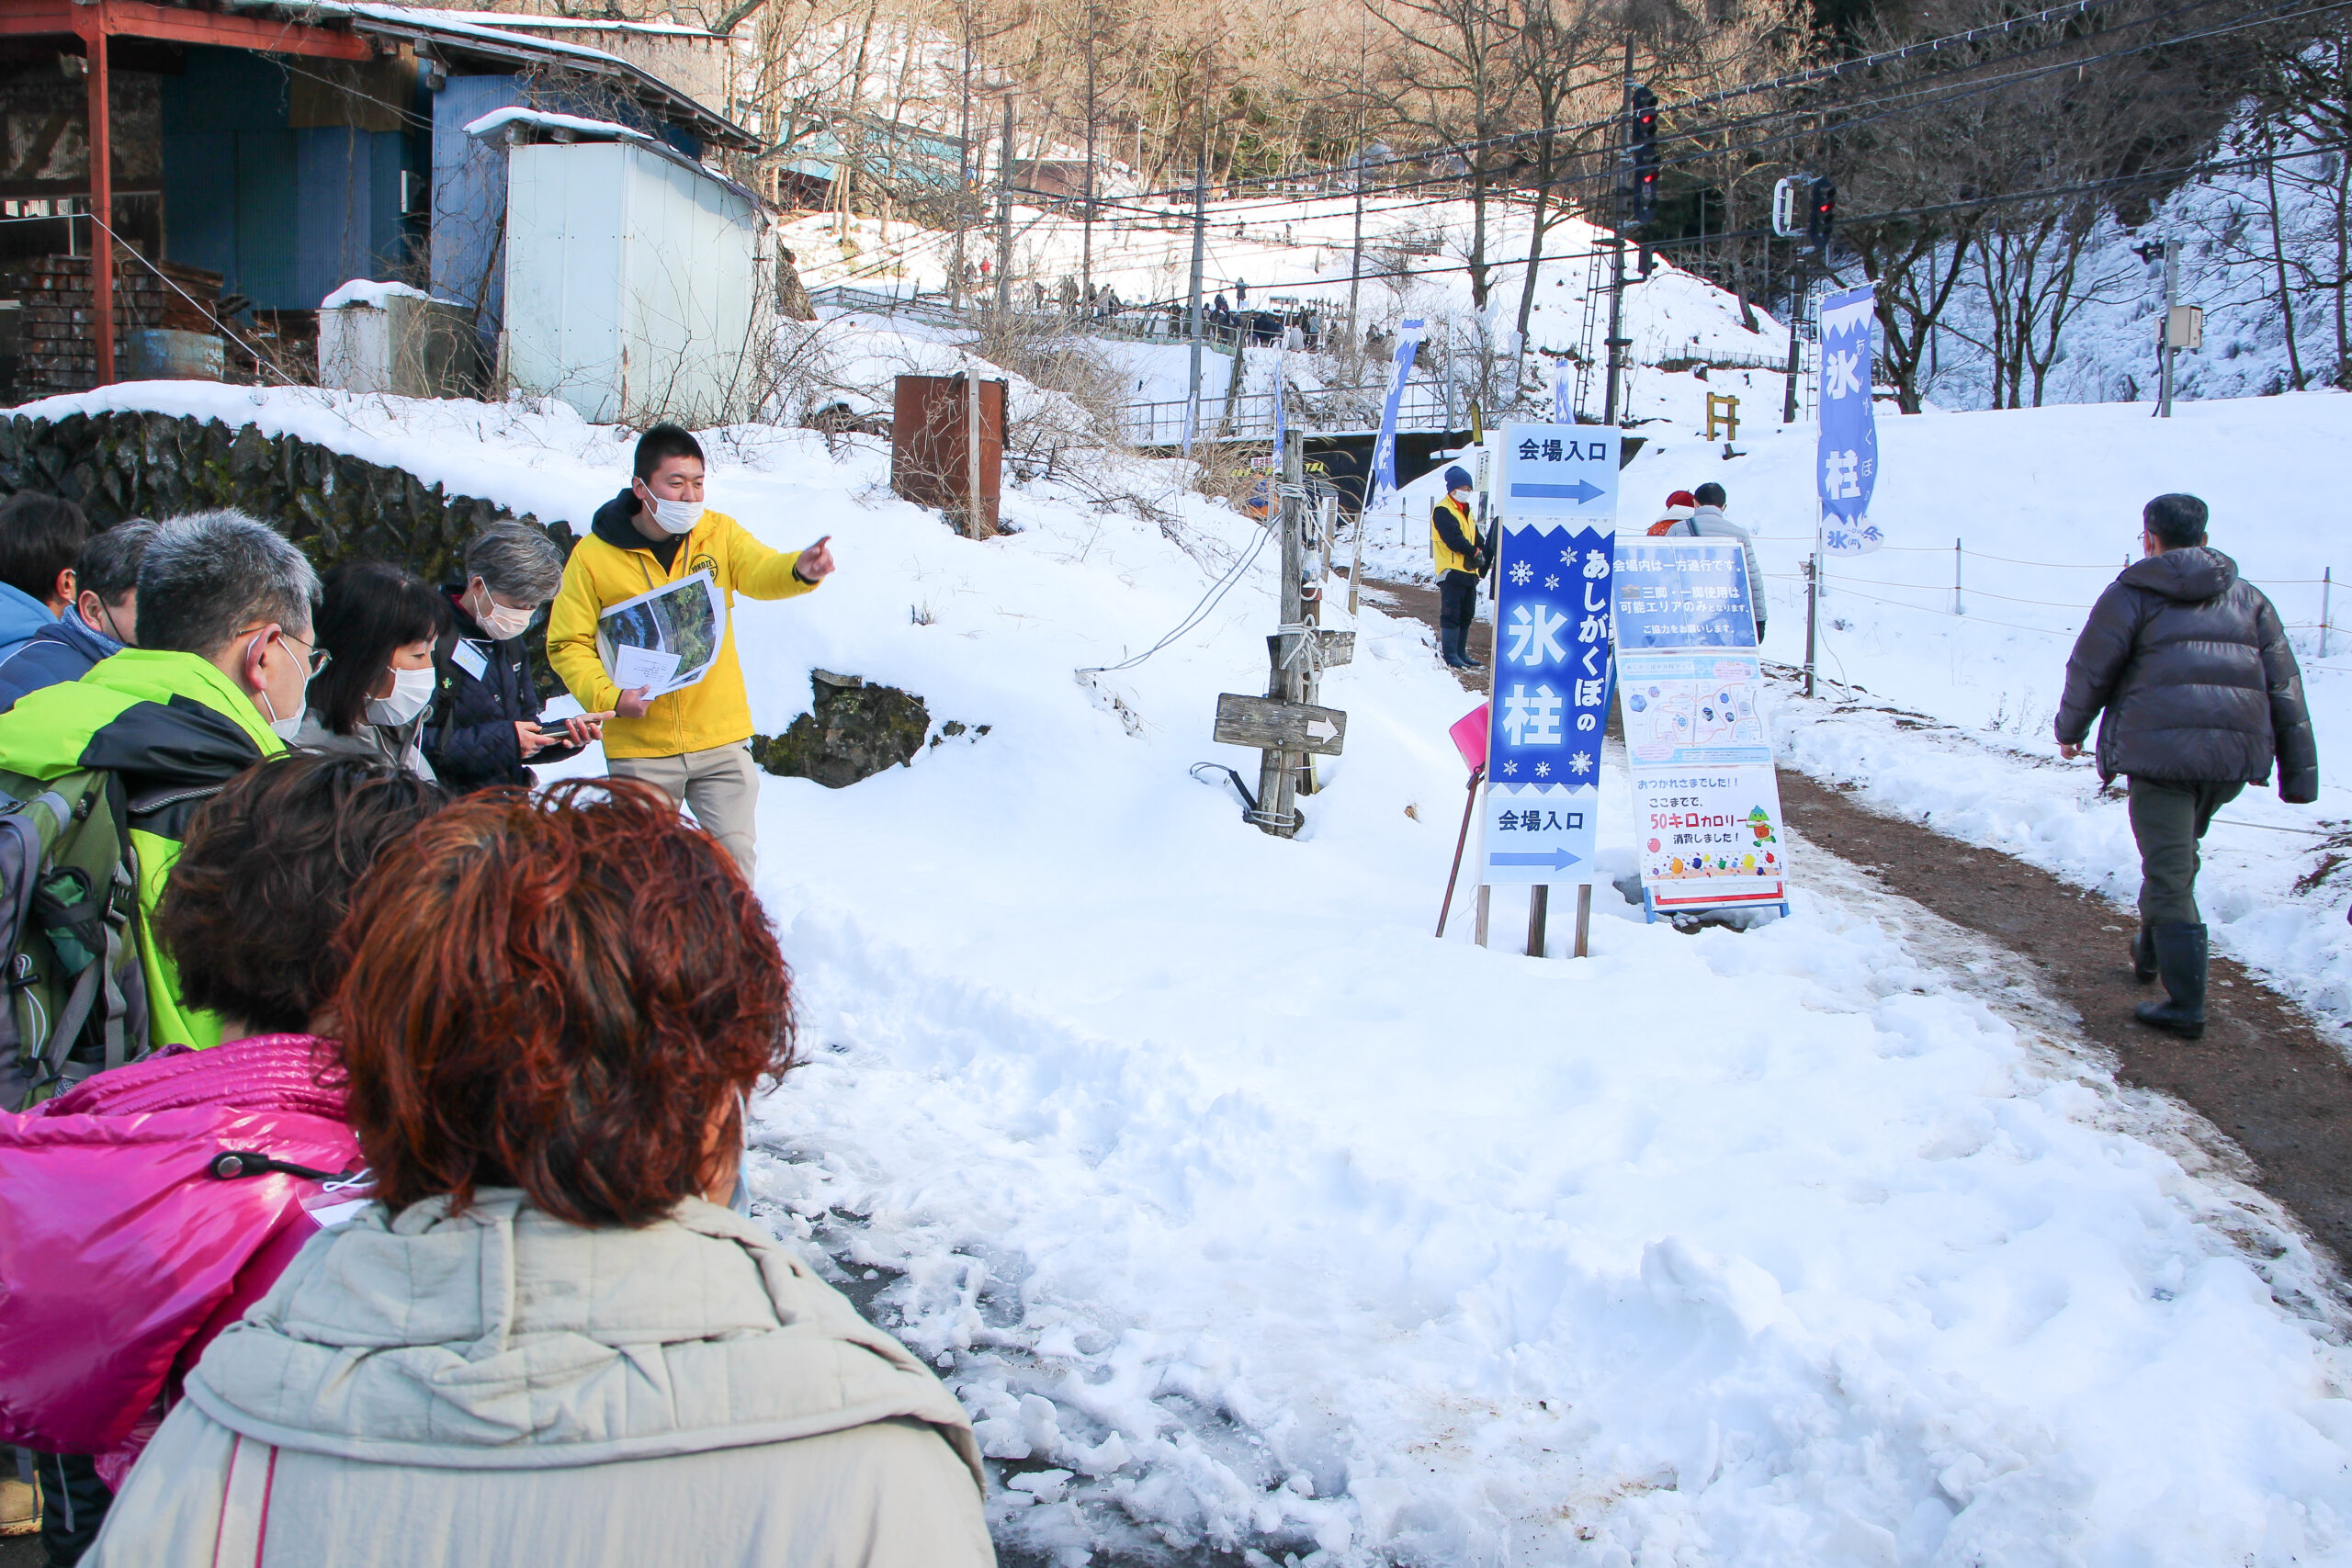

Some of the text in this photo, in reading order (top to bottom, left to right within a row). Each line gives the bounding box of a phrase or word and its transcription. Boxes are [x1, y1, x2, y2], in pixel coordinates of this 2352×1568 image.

[1825, 350, 1861, 501] 氷柱
[1519, 438, 1606, 461] 会場入口
[1612, 559, 1741, 572] 会場内は一方通行です。
[1642, 586, 1740, 599] 三脚・一脚使用は
[1619, 600, 1749, 615] 可能エリアのみとなります。
[1643, 624, 1735, 635] ご協力をお願いします。
[1575, 549, 1610, 732] あしがくぼの
[1502, 604, 1567, 746] 氷柱
[1649, 796, 1703, 808] ここまでで、
[1498, 810, 1584, 832] 会場入口
[1650, 812, 1747, 830] 50キロカロリー
[1673, 832, 1739, 845] 消費しました！
